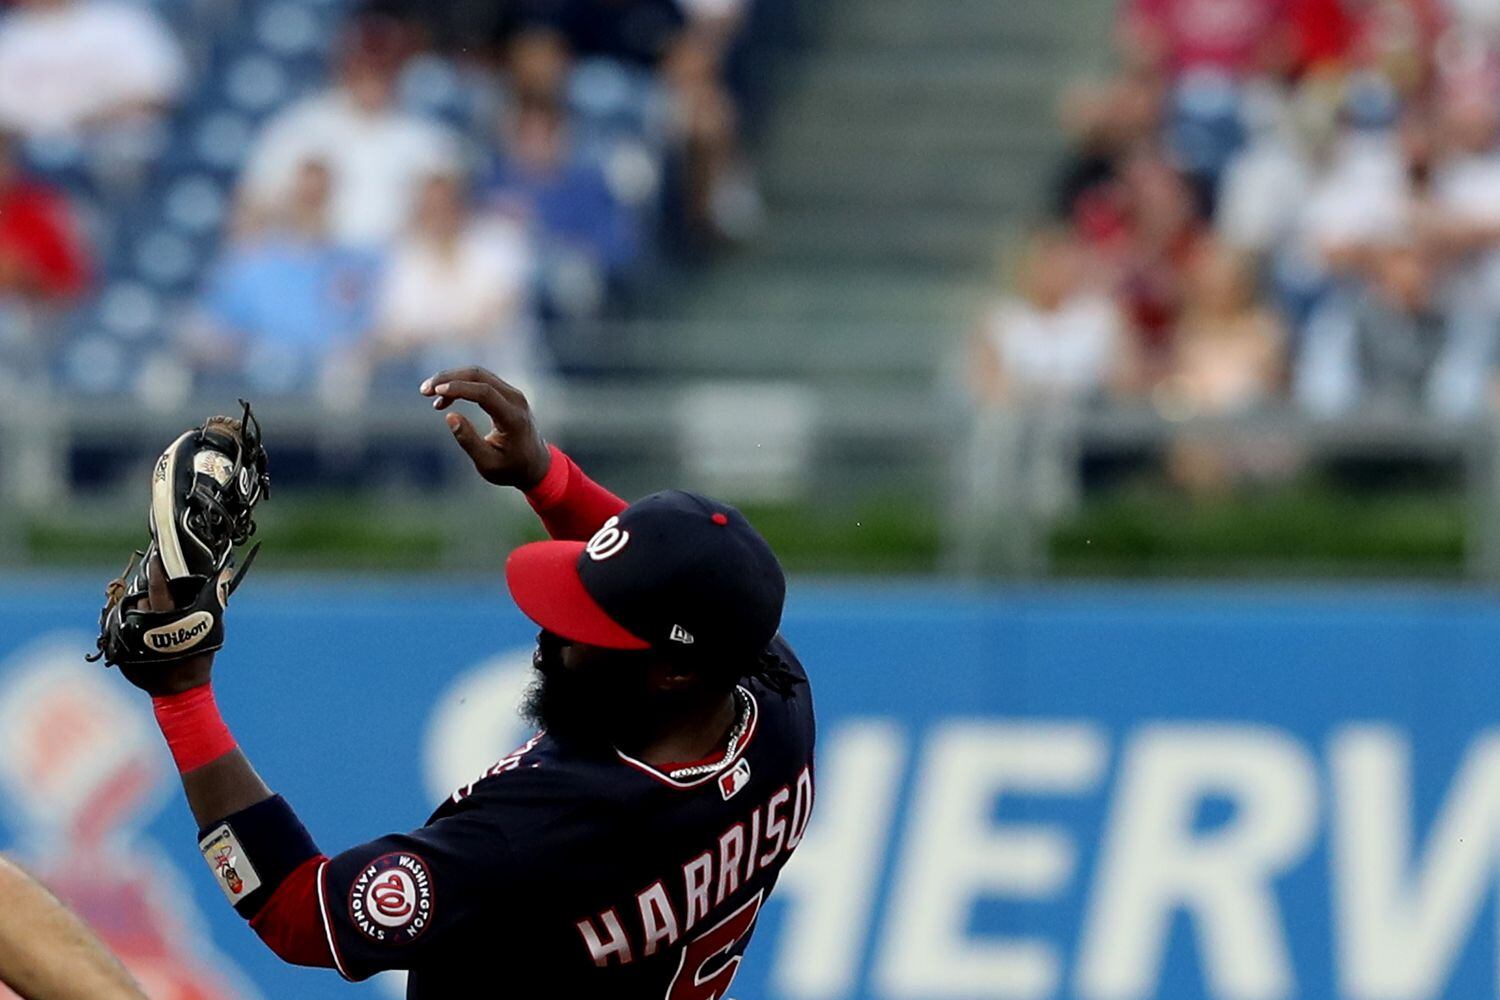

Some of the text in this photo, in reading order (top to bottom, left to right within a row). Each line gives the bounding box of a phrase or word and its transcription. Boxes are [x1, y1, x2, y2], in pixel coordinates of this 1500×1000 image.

[151, 616, 208, 650] Wilson
[352, 865, 385, 940] NATIONALS
[398, 855, 430, 937] WASHINGTON
